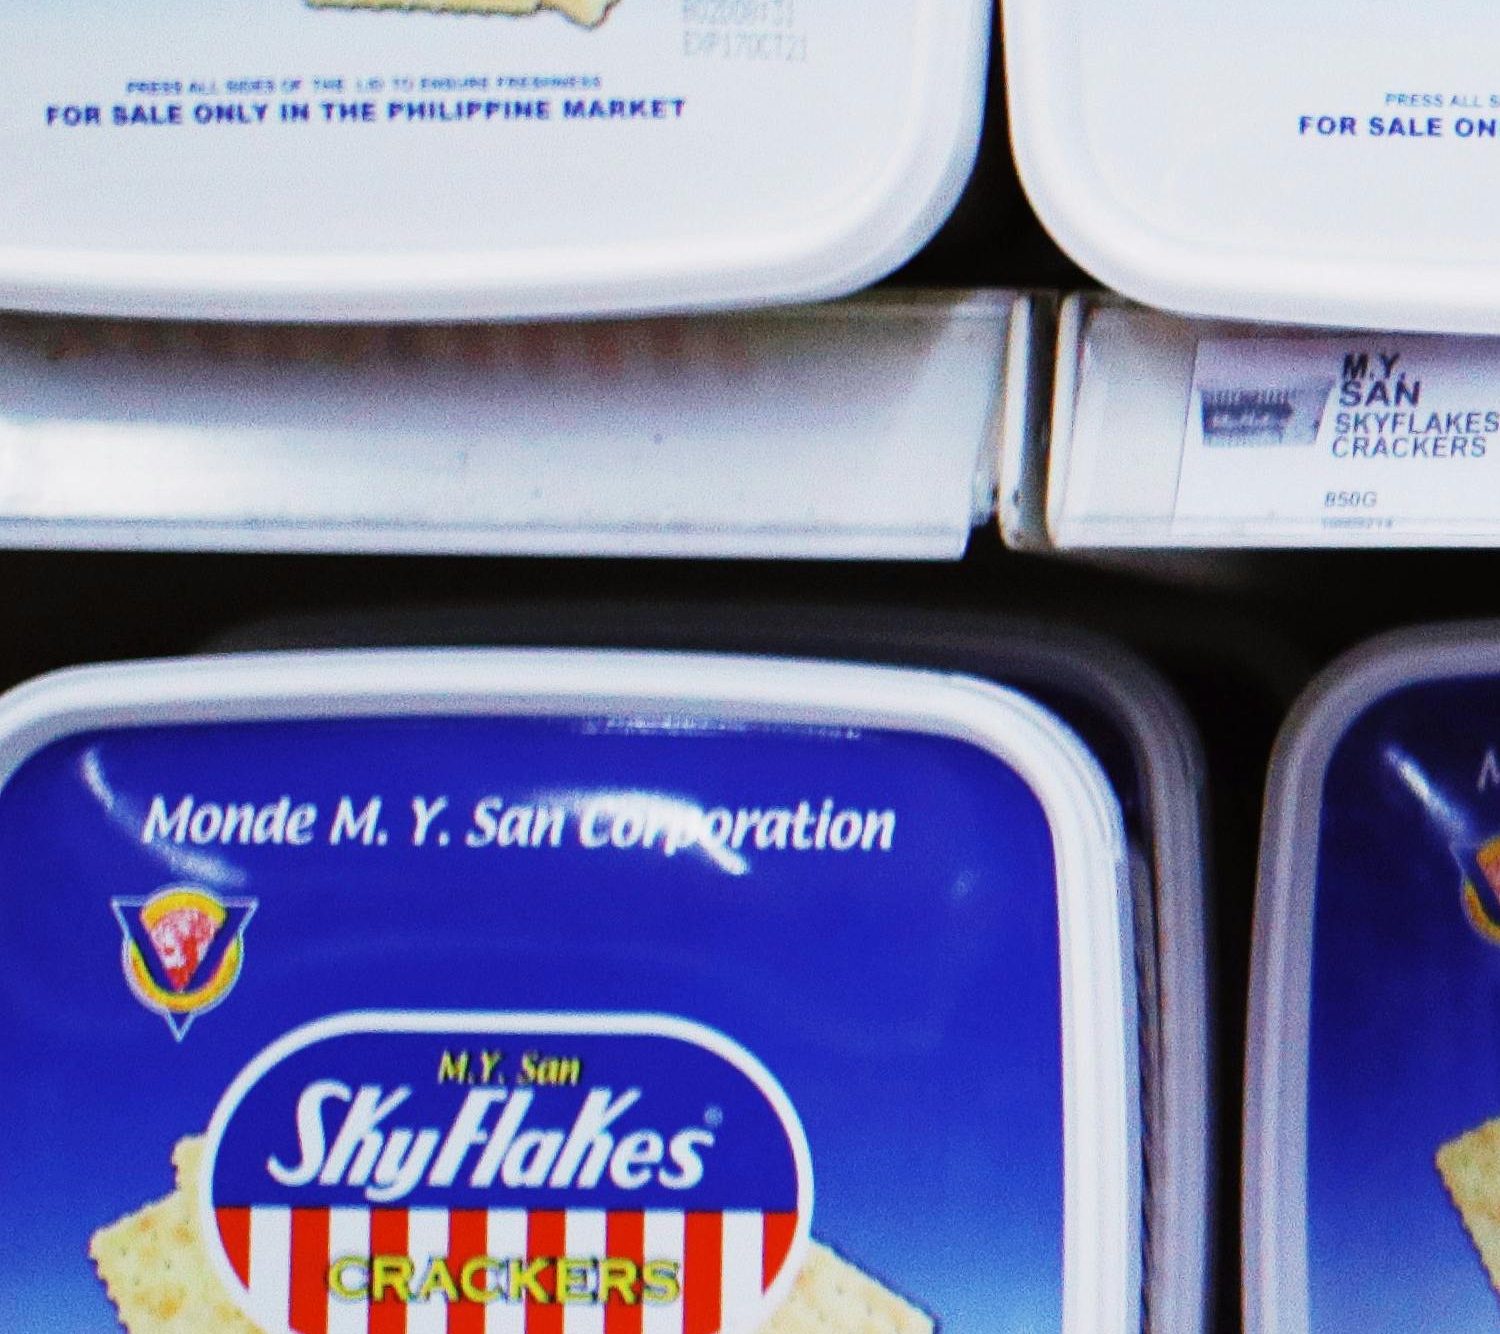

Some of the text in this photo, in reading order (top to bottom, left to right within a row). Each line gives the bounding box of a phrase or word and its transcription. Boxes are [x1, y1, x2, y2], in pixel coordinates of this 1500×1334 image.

[1386, 93, 1443, 107] PRESS
[1451, 95, 1479, 107] ALL
[1300, 116, 1356, 135] FOR
[1370, 117, 1440, 136] SALE
[1341, 351, 1407, 382] M.Y.
[1340, 380, 1420, 406] SAN
[1337, 411, 1499, 434] SKYFLAKES
[1331, 436, 1489, 461] CRACKERS
[141, 795, 897, 863] Monde M. Y. San Corporation
[437, 1051, 581, 1086] M.Y. San
[265, 1080, 716, 1204] SkyFlakes
[328, 1256, 682, 1307] CRACKERS
